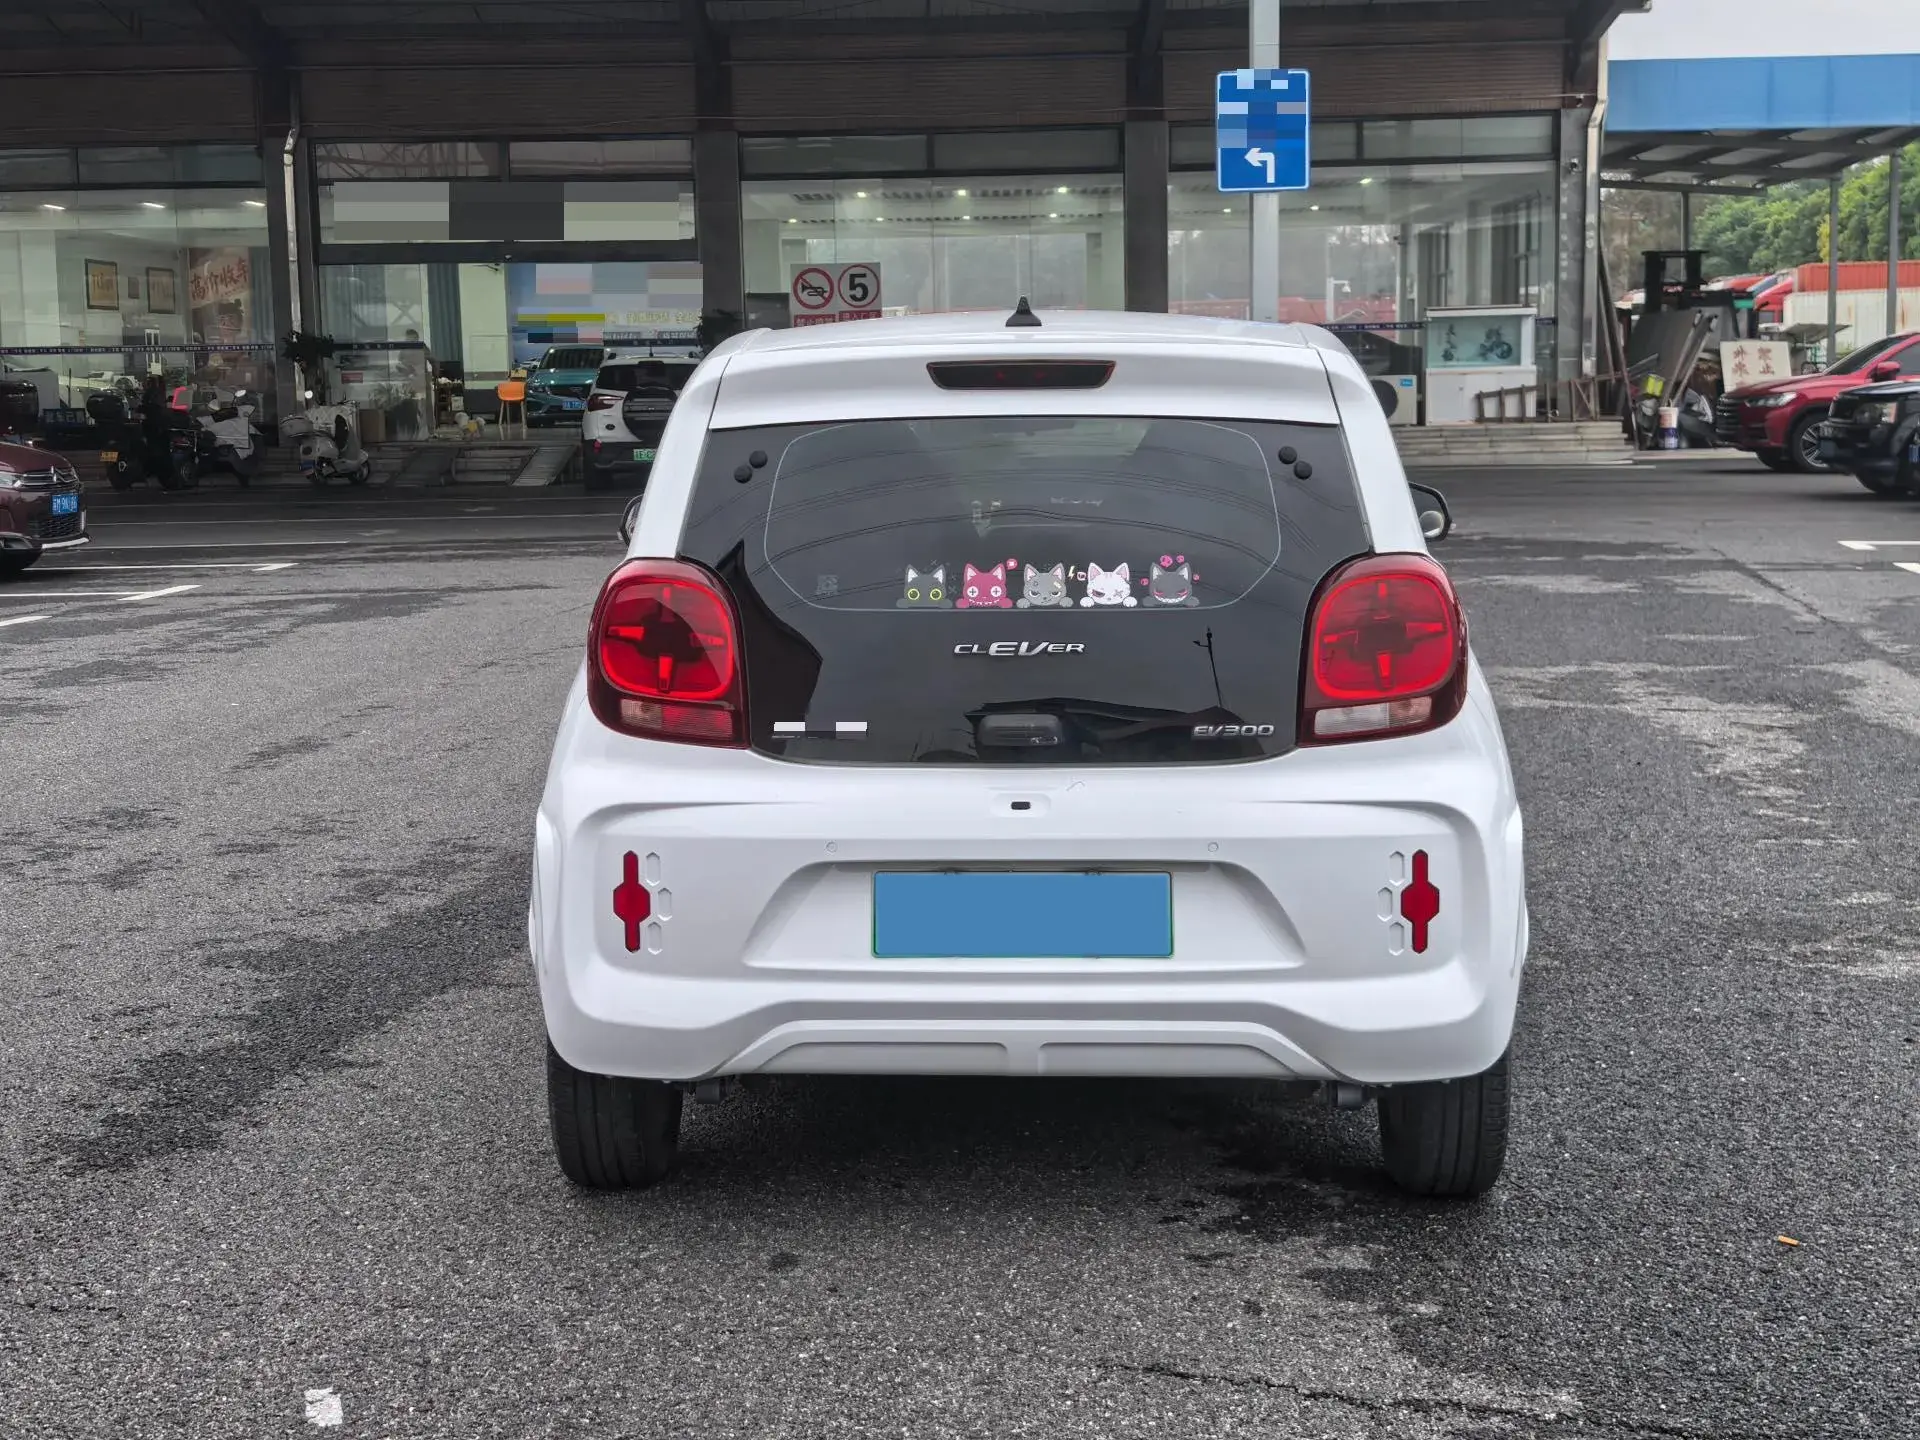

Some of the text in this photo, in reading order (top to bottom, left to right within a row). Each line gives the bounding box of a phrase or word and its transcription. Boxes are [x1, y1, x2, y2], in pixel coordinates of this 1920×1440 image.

[191, 257, 247, 301] 高价收车
[849, 273, 869, 302] 5
[1731, 344, 1750, 386] 外来
[954, 641, 1085, 656] CLEVER
[1193, 724, 1274, 736] EV300
